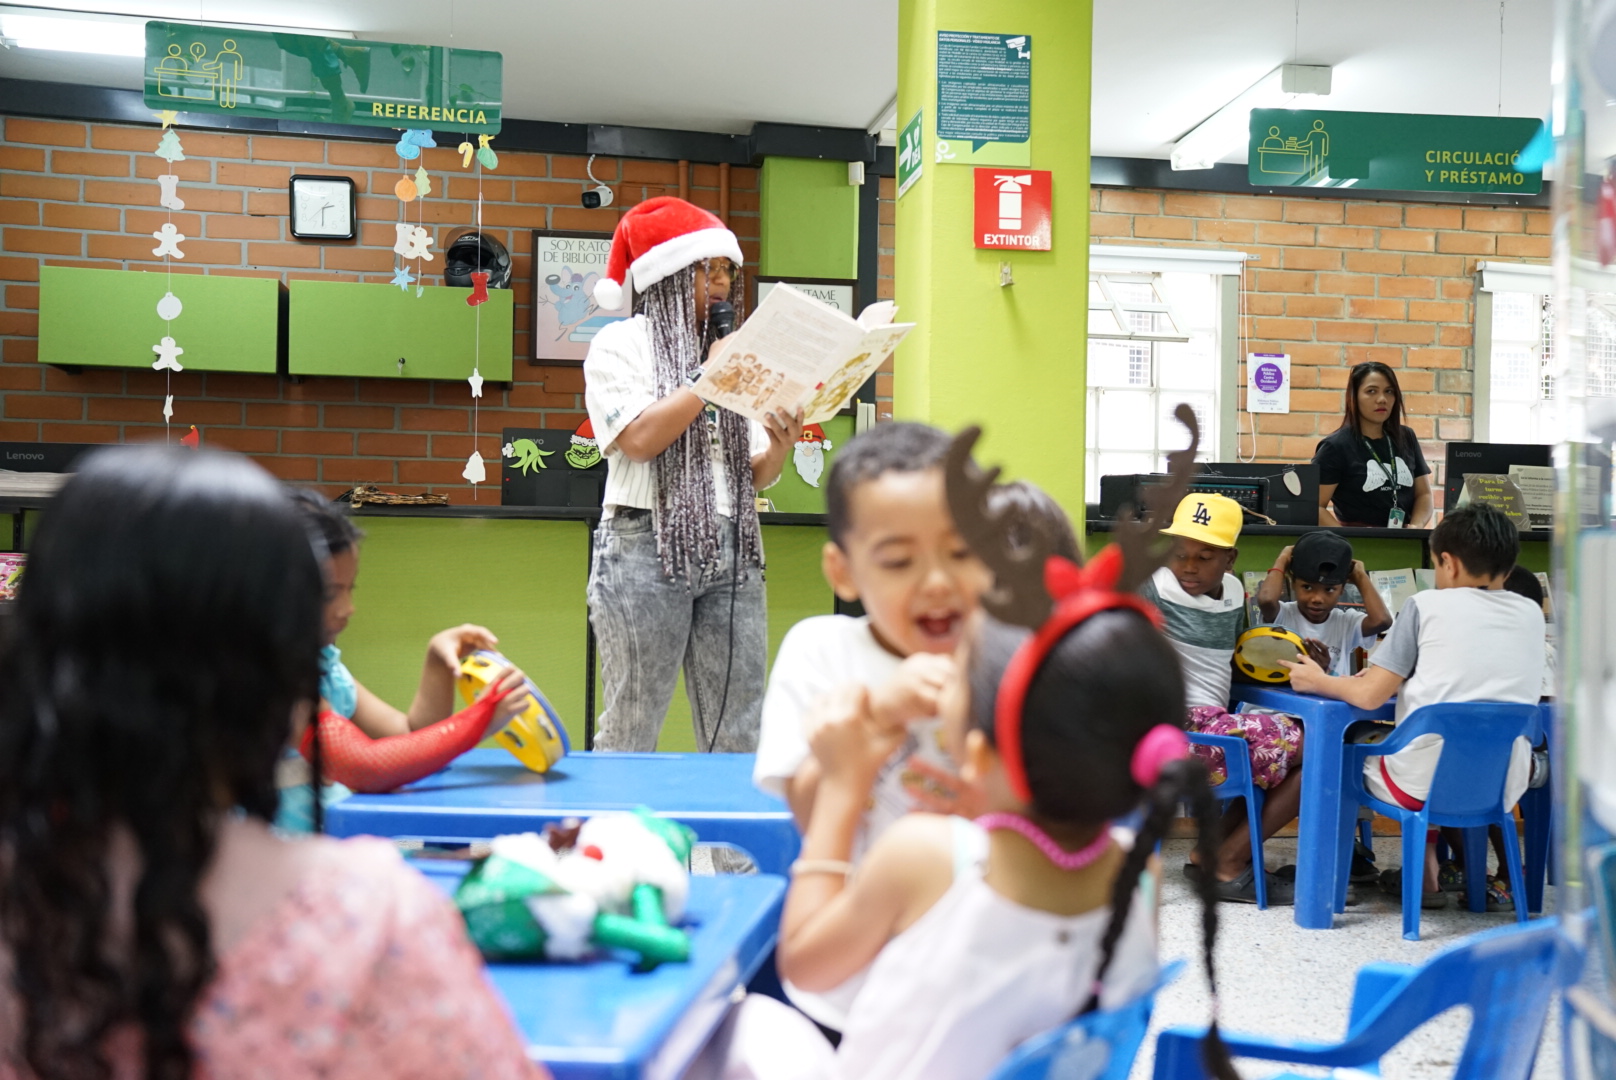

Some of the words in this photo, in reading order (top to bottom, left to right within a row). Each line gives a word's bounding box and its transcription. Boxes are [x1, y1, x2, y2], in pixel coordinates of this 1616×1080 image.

[372, 102, 487, 124] REFERENCIA
[1425, 149, 1520, 166] CIRCULACIÓ
[1425, 169, 1434, 182] Y
[1440, 167, 1524, 185] PRÉSTAMO
[551, 239, 575, 251] SOY
[578, 240, 612, 252] RATÓ
[983, 233, 1040, 246] EXTINTOR
[543, 251, 559, 262] DE
[562, 252, 609, 264] BIBLIOTE
[6, 451, 45, 460] Lenovo
[1455, 450, 1482, 458] Lenovo
[1192, 502, 1211, 526] LA
